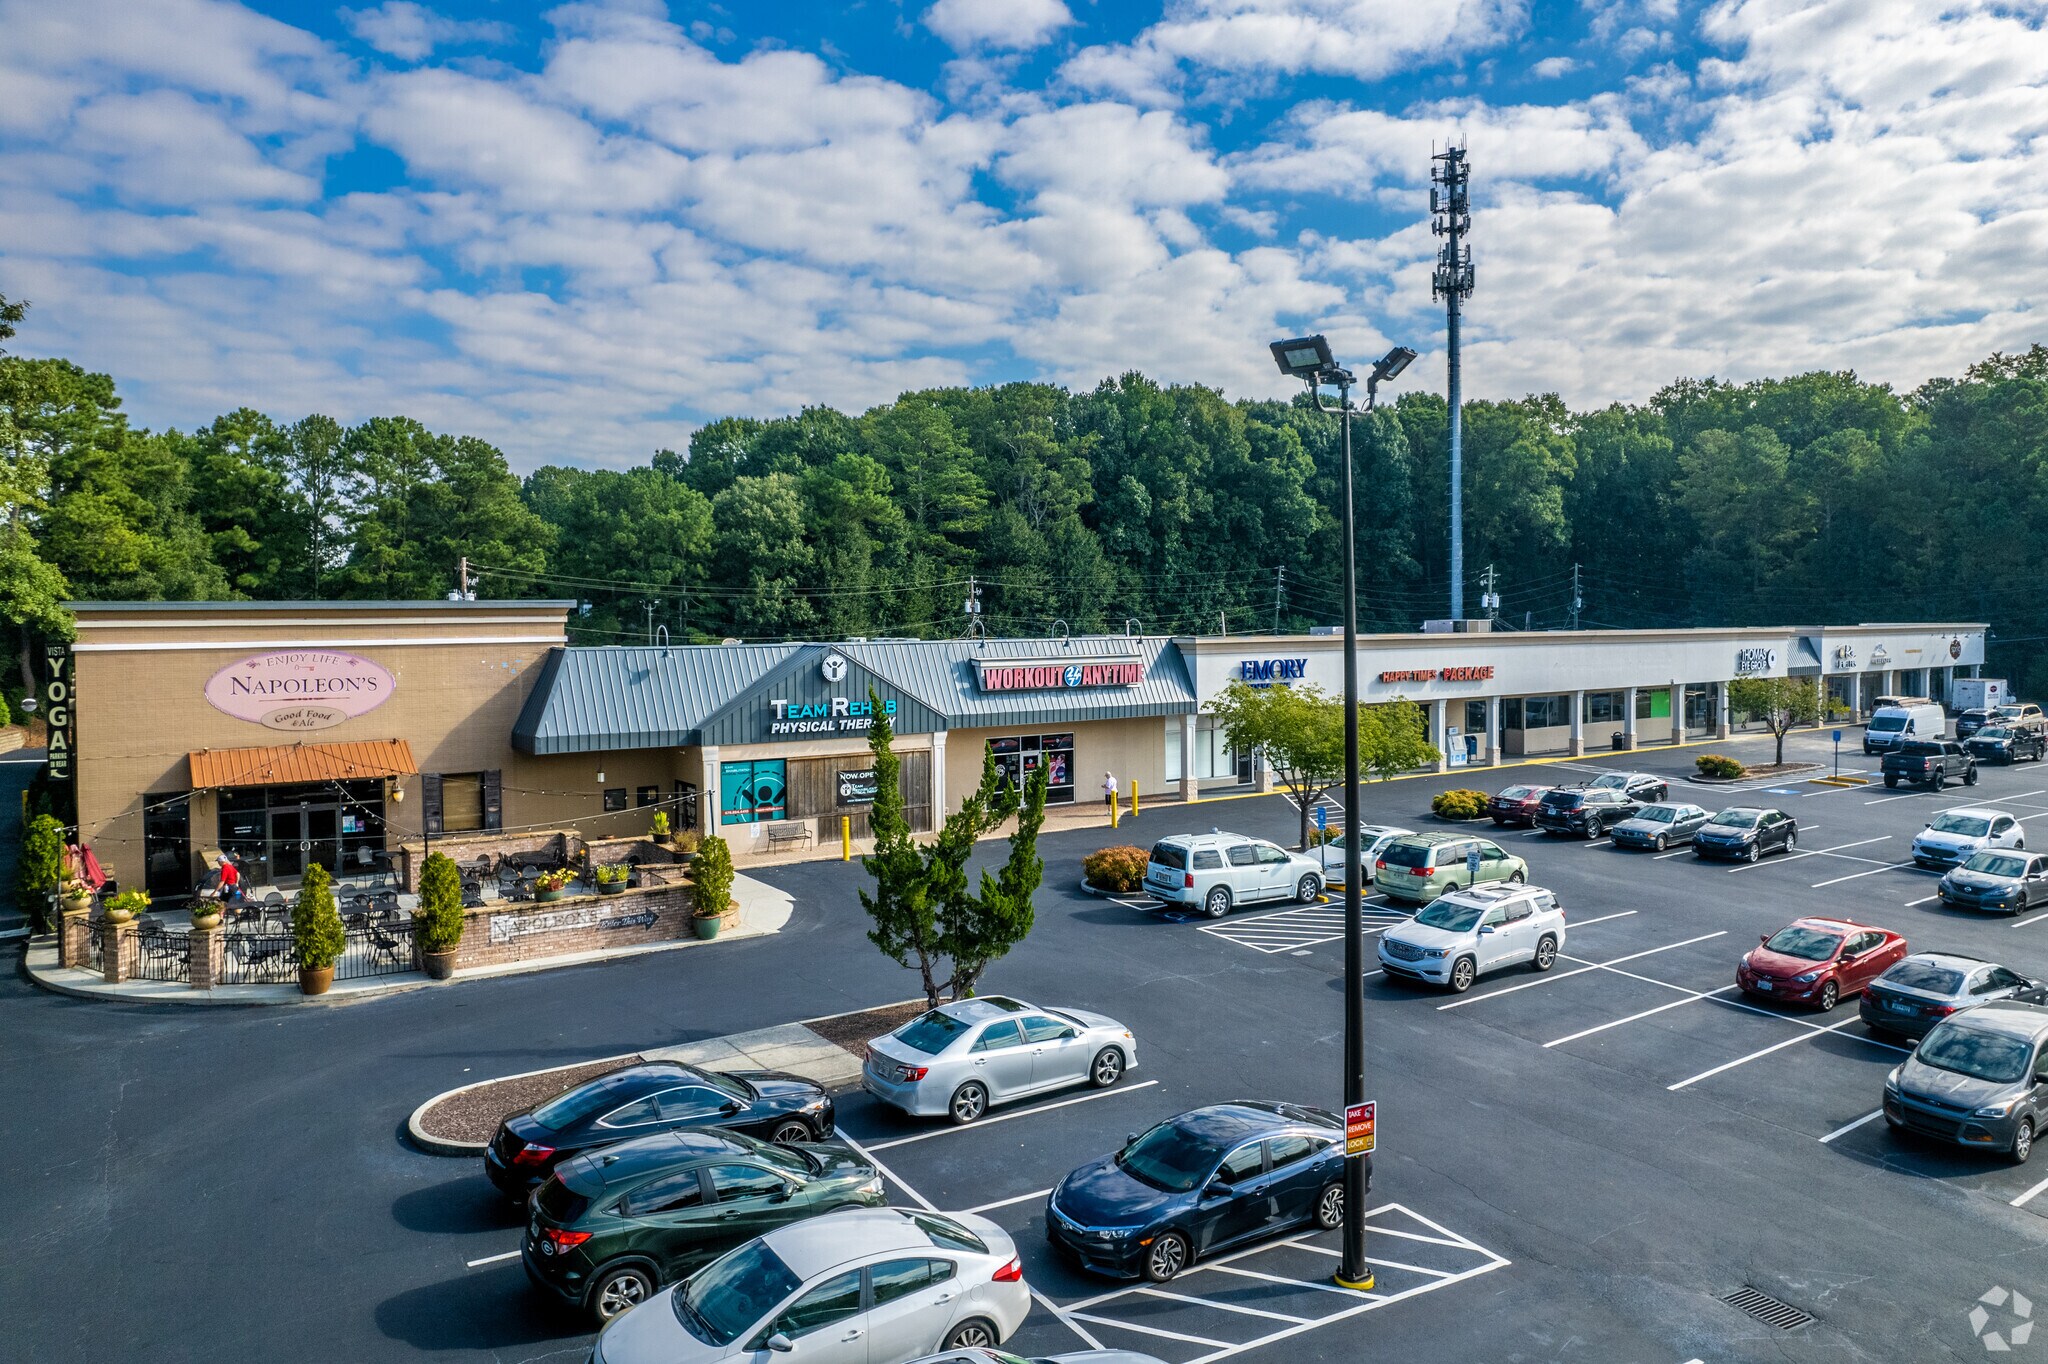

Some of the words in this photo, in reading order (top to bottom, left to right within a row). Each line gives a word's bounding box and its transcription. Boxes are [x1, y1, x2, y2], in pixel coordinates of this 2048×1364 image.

[47, 646, 66, 656] VISTA
[1740, 648, 1767, 661] THOMAS
[266, 653, 308, 667] ENJOY
[312, 653, 341, 666] LIFE
[1741, 661, 1750, 671] EYE
[1750, 660, 1767, 670] GROUP
[985, 665, 1064, 690] WORKOUT
[1083, 663, 1145, 686] ANYTIME
[1240, 658, 1308, 681] EMORY
[1382, 670, 1410, 683] HAPPY
[1412, 669, 1437, 682] TIMES
[1442, 665, 1495, 681] PACKAGE
[230, 675, 378, 696] NAPOLEON'S
[47, 657, 68, 751] YOGA
[770, 698, 828, 720] TEAM
[274, 708, 302, 724] Good
[306, 709, 334, 721] Food
[298, 718, 315, 728] Ale
[771, 719, 836, 734] PHYSICAL
[839, 716, 897, 731] THERY
[840, 772, 858, 780] NOW
[601, 919, 622, 929] Enter
[622, 917, 636, 926] This
[637, 914, 654, 925] Way
[1348, 1109, 1362, 1119] TAKE
[1347, 1121, 1372, 1134] REMOVE
[1347, 1139, 1364, 1149] LOCK
